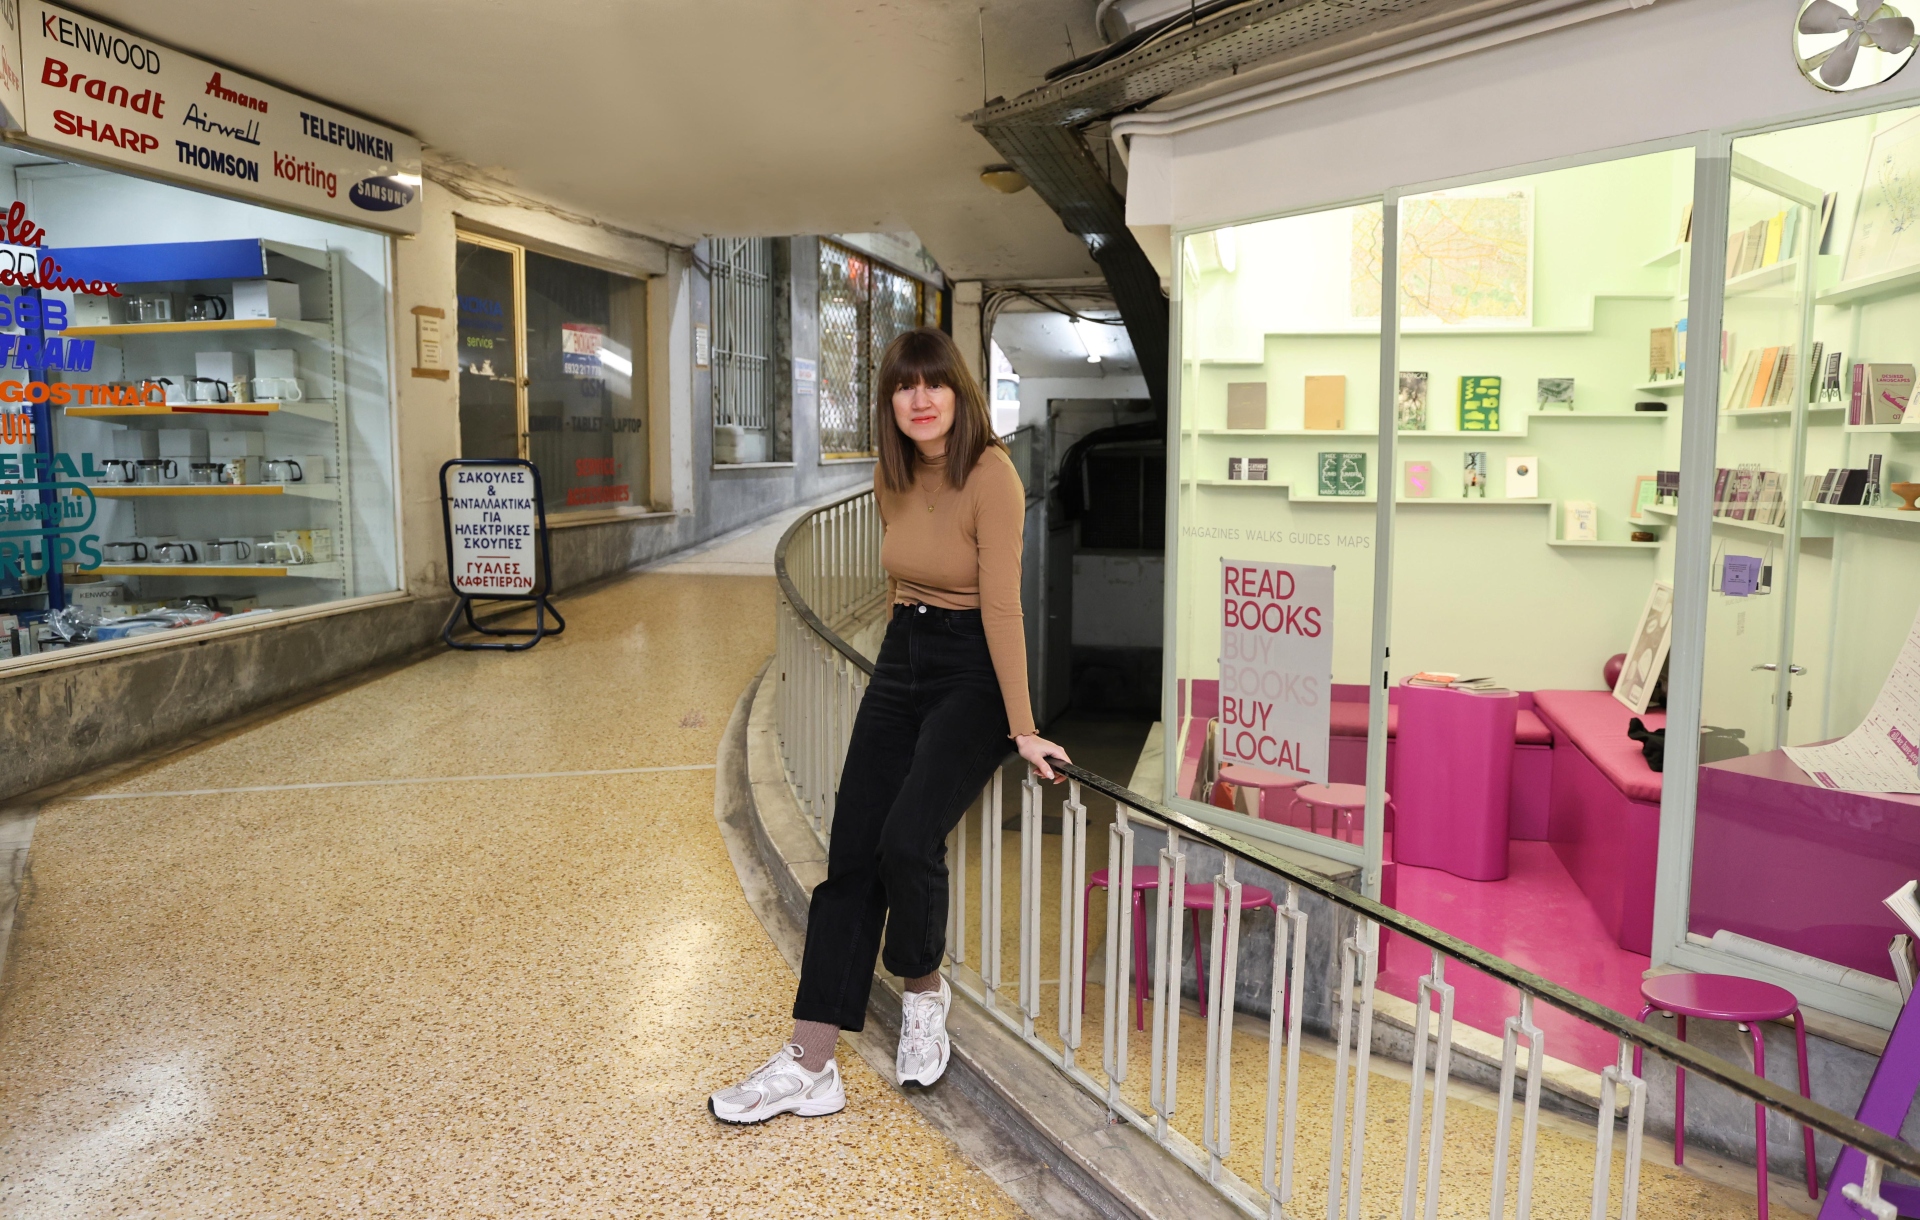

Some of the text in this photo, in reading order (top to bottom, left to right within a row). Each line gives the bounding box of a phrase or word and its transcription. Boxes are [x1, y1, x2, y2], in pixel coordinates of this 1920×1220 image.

[42, 11, 160, 75] KENWOOD
[41, 56, 165, 119] Brandt
[205, 71, 268, 114] Amana
[53, 109, 159, 154] SHARP
[182, 103, 260, 146] Airwell
[300, 111, 393, 163] TELEFUNKEN
[176, 139, 258, 182] THOMSON
[273, 151, 337, 198] körting
[357, 180, 408, 206] SAMSUNG
[466, 335, 493, 349] service
[0, 380, 140, 406] GOSTINA
[612, 417, 642, 433] LAPTOP
[458, 472, 525, 484] ΣΑΚΟΥΛΕΣ
[487, 485, 496, 496] &
[453, 498, 531, 510] ΑΝΤΑΛΛΑΚΤΙΚΑ
[483, 512, 501, 522] ΓΙΑ
[455, 524, 530, 536] ΗΛΕΚΤΡΙΚΕΣ
[464, 538, 522, 550] ΣΚΟΥΠΕΣ
[1182, 526, 1370, 549] MAGAZINES WALKS GUIDES MAPS
[457, 576, 532, 588] ΚΑΦΕΤΙΕΡΩΝ
[467, 562, 520, 575] ΓΥΑΛΕΣ
[1224, 566, 1295, 600] READ
[80, 591, 118, 599] KENWOOD
[1224, 598, 1321, 638] BOOKS
[1223, 631, 1274, 664] BUY
[1223, 664, 1319, 707] BOOKS
[1223, 695, 1273, 731] BUY
[1222, 727, 1311, 774] LOCAL
